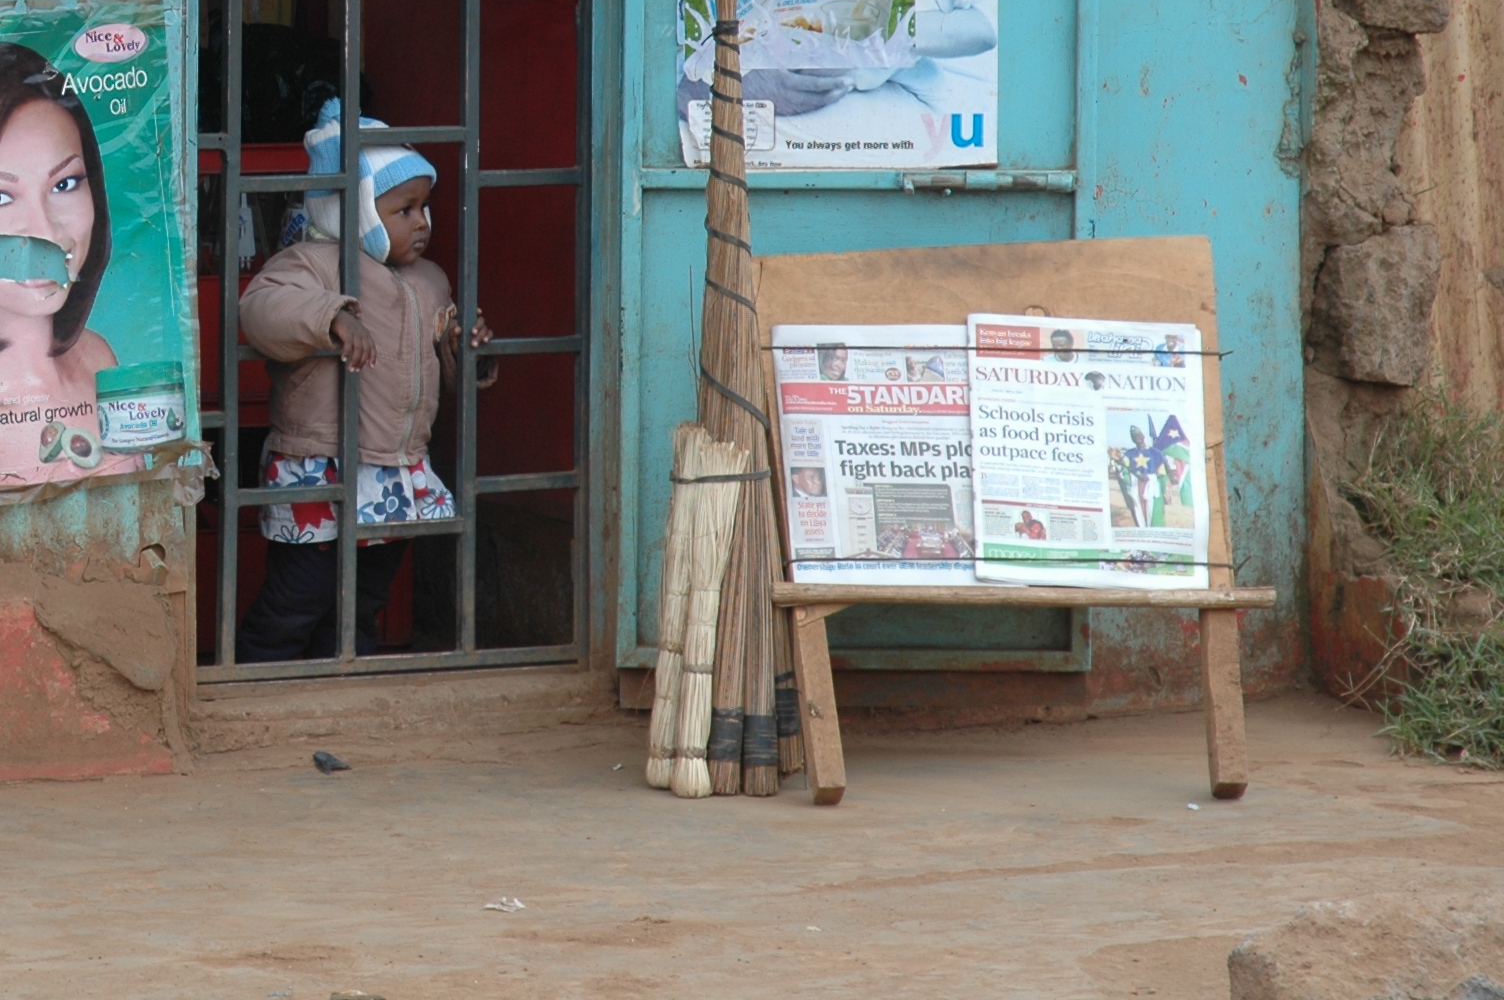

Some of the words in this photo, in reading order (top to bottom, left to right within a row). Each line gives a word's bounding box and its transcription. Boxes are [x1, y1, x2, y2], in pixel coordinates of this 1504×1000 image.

[85, 31, 111, 43] Nice
[113, 33, 124, 44] &
[106, 39, 140, 53] Lovely
[61, 66, 147, 96] Avocado
[110, 98, 127, 115] Oil
[786, 140, 804, 149] You
[807, 140, 842, 152] always
[845, 141, 861, 152] get
[891, 140, 914, 149] with
[975, 366, 1083, 387] SATURDAY
[1108, 373, 1186, 392] NATION
[847, 385, 969, 405] STANDAR
[45, 401, 93, 423] growth
[109, 401, 136, 412] Nice
[129, 407, 166, 420] Lovely
[865, 405, 922, 416] Saturday.
[979, 405, 1045, 423] Schools
[1049, 410, 1094, 427] crisis
[979, 426, 997, 438] as
[1002, 425, 1039, 441] food
[1044, 429, 1095, 446] prices
[834, 440, 895, 456] Taxes:
[900, 441, 941, 457] MPs
[980, 444, 1047, 461] outpace
[1052, 447, 1084, 463] fees
[840, 460, 886, 480] fight
[890, 461, 936, 478] back
